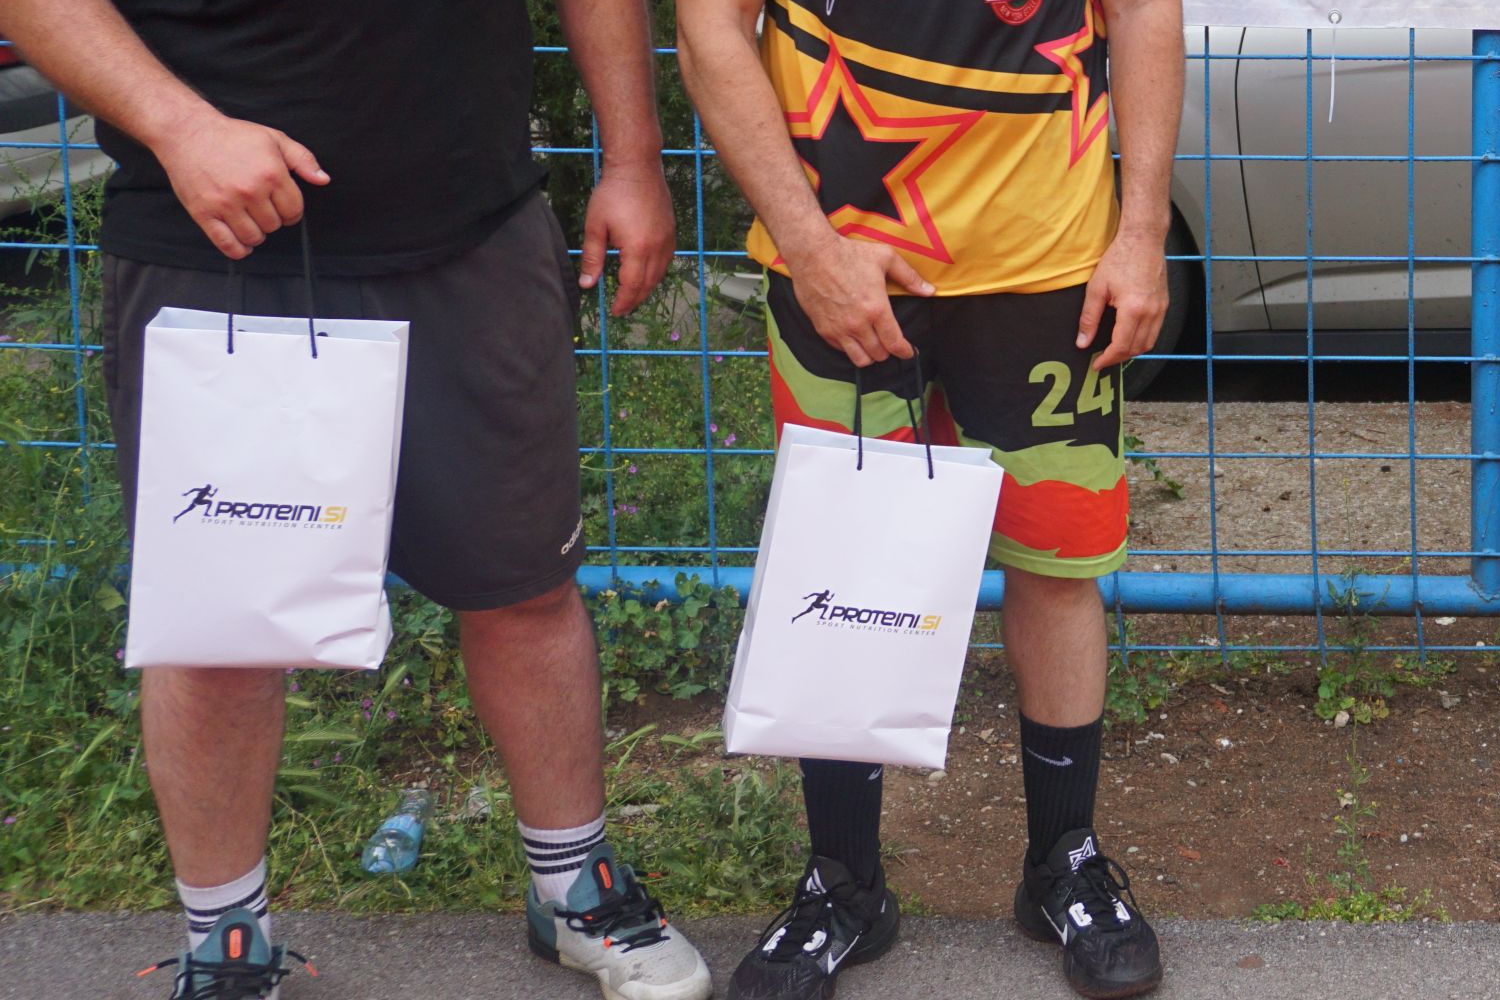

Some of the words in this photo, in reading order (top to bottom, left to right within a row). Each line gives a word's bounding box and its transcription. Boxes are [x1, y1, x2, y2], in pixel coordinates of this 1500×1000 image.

[1028, 351, 1114, 427] 24
[200, 517, 235, 525] SPORT
[239, 520, 298, 529] NUTRITION
[816, 620, 846, 628] SPORT
[849, 624, 899, 634] NUTRITION
[903, 628, 937, 636] CENTER
